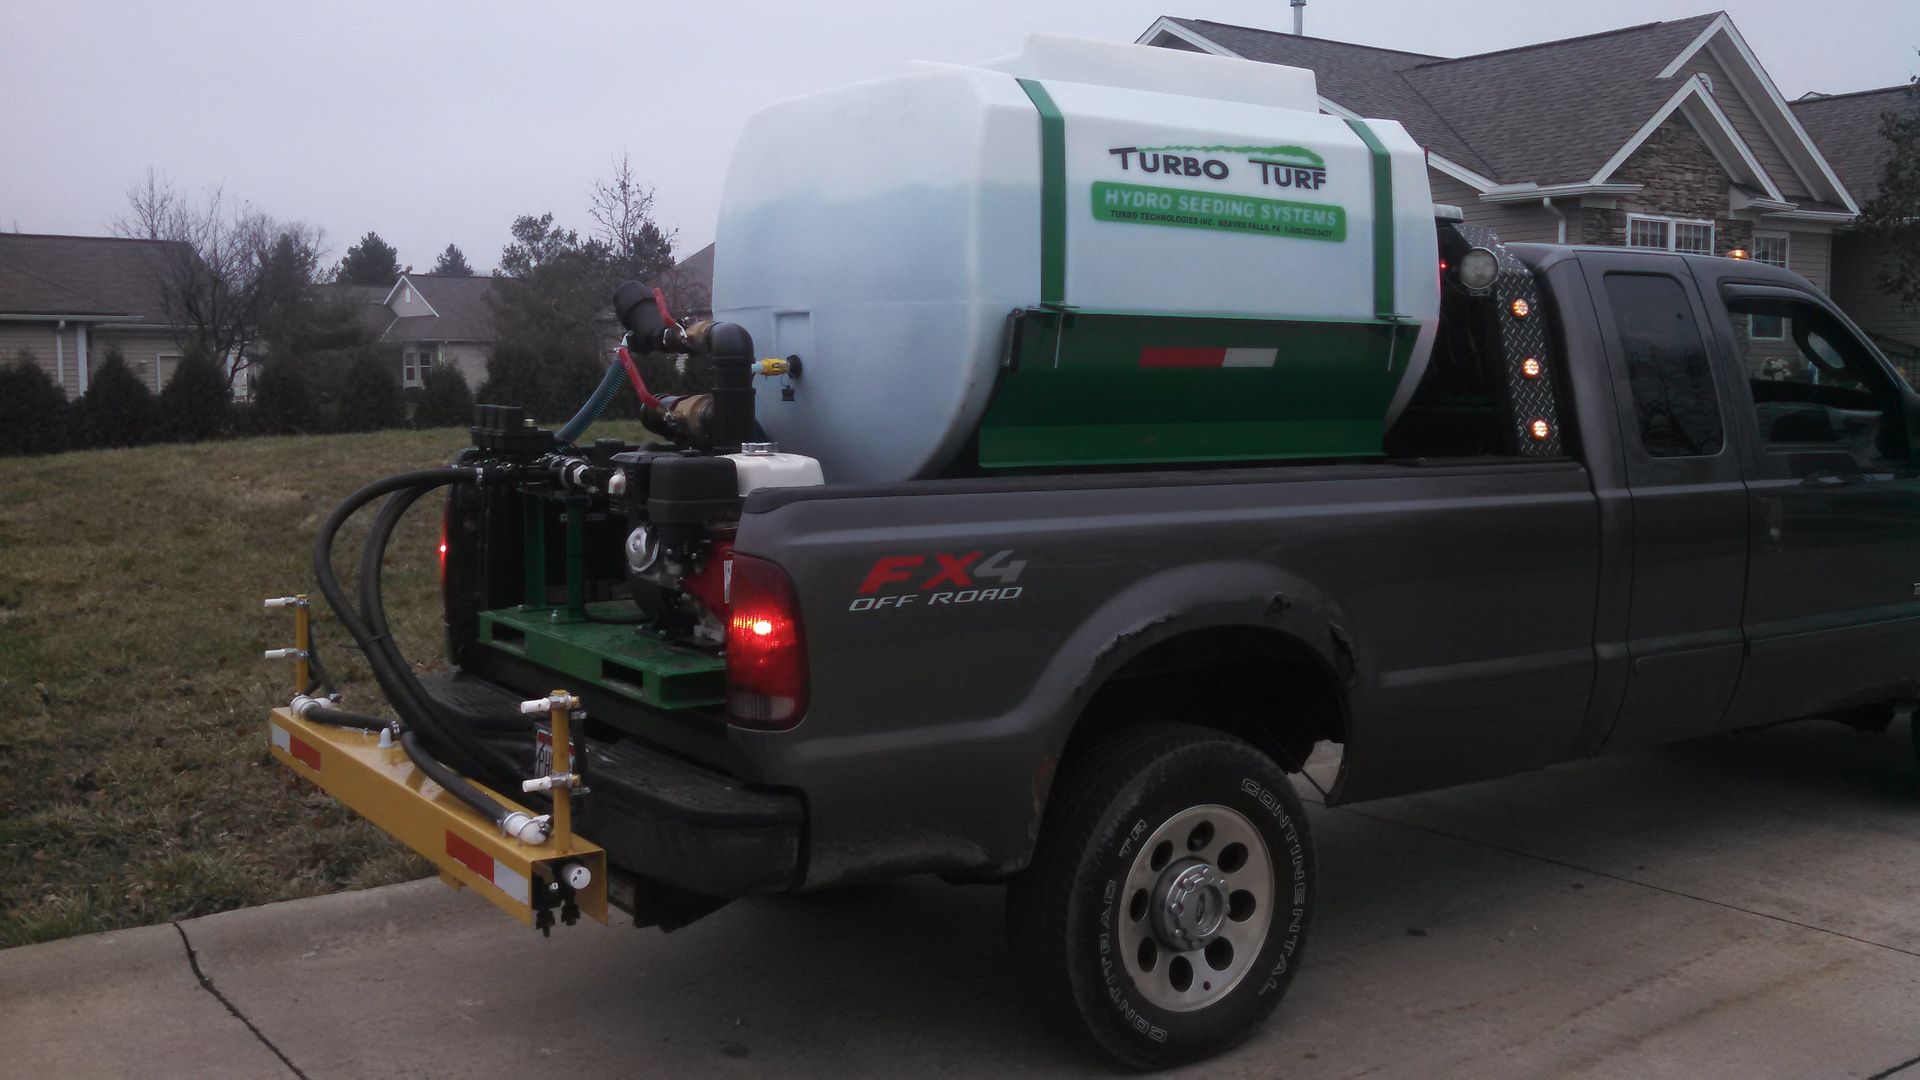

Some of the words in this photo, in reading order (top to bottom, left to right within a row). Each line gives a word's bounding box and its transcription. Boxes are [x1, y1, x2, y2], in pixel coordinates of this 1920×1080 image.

[1108, 146, 1230, 181] TURBO
[1248, 158, 1326, 190] TURF
[1104, 188, 1172, 210] HYDRO
[1178, 195, 1254, 218] SEEDING
[1261, 204, 1337, 227] SYSTEMS
[1110, 209, 1138, 219] TURBO
[1140, 212, 1198, 225] TECHNOLOGIES
[857, 550, 1028, 594] FX4
[849, 594, 918, 611] OFF
[927, 586, 1022, 606] ROAD
[1119, 819, 1148, 858] TR
[1241, 778, 1305, 996] CONTINENTAL
